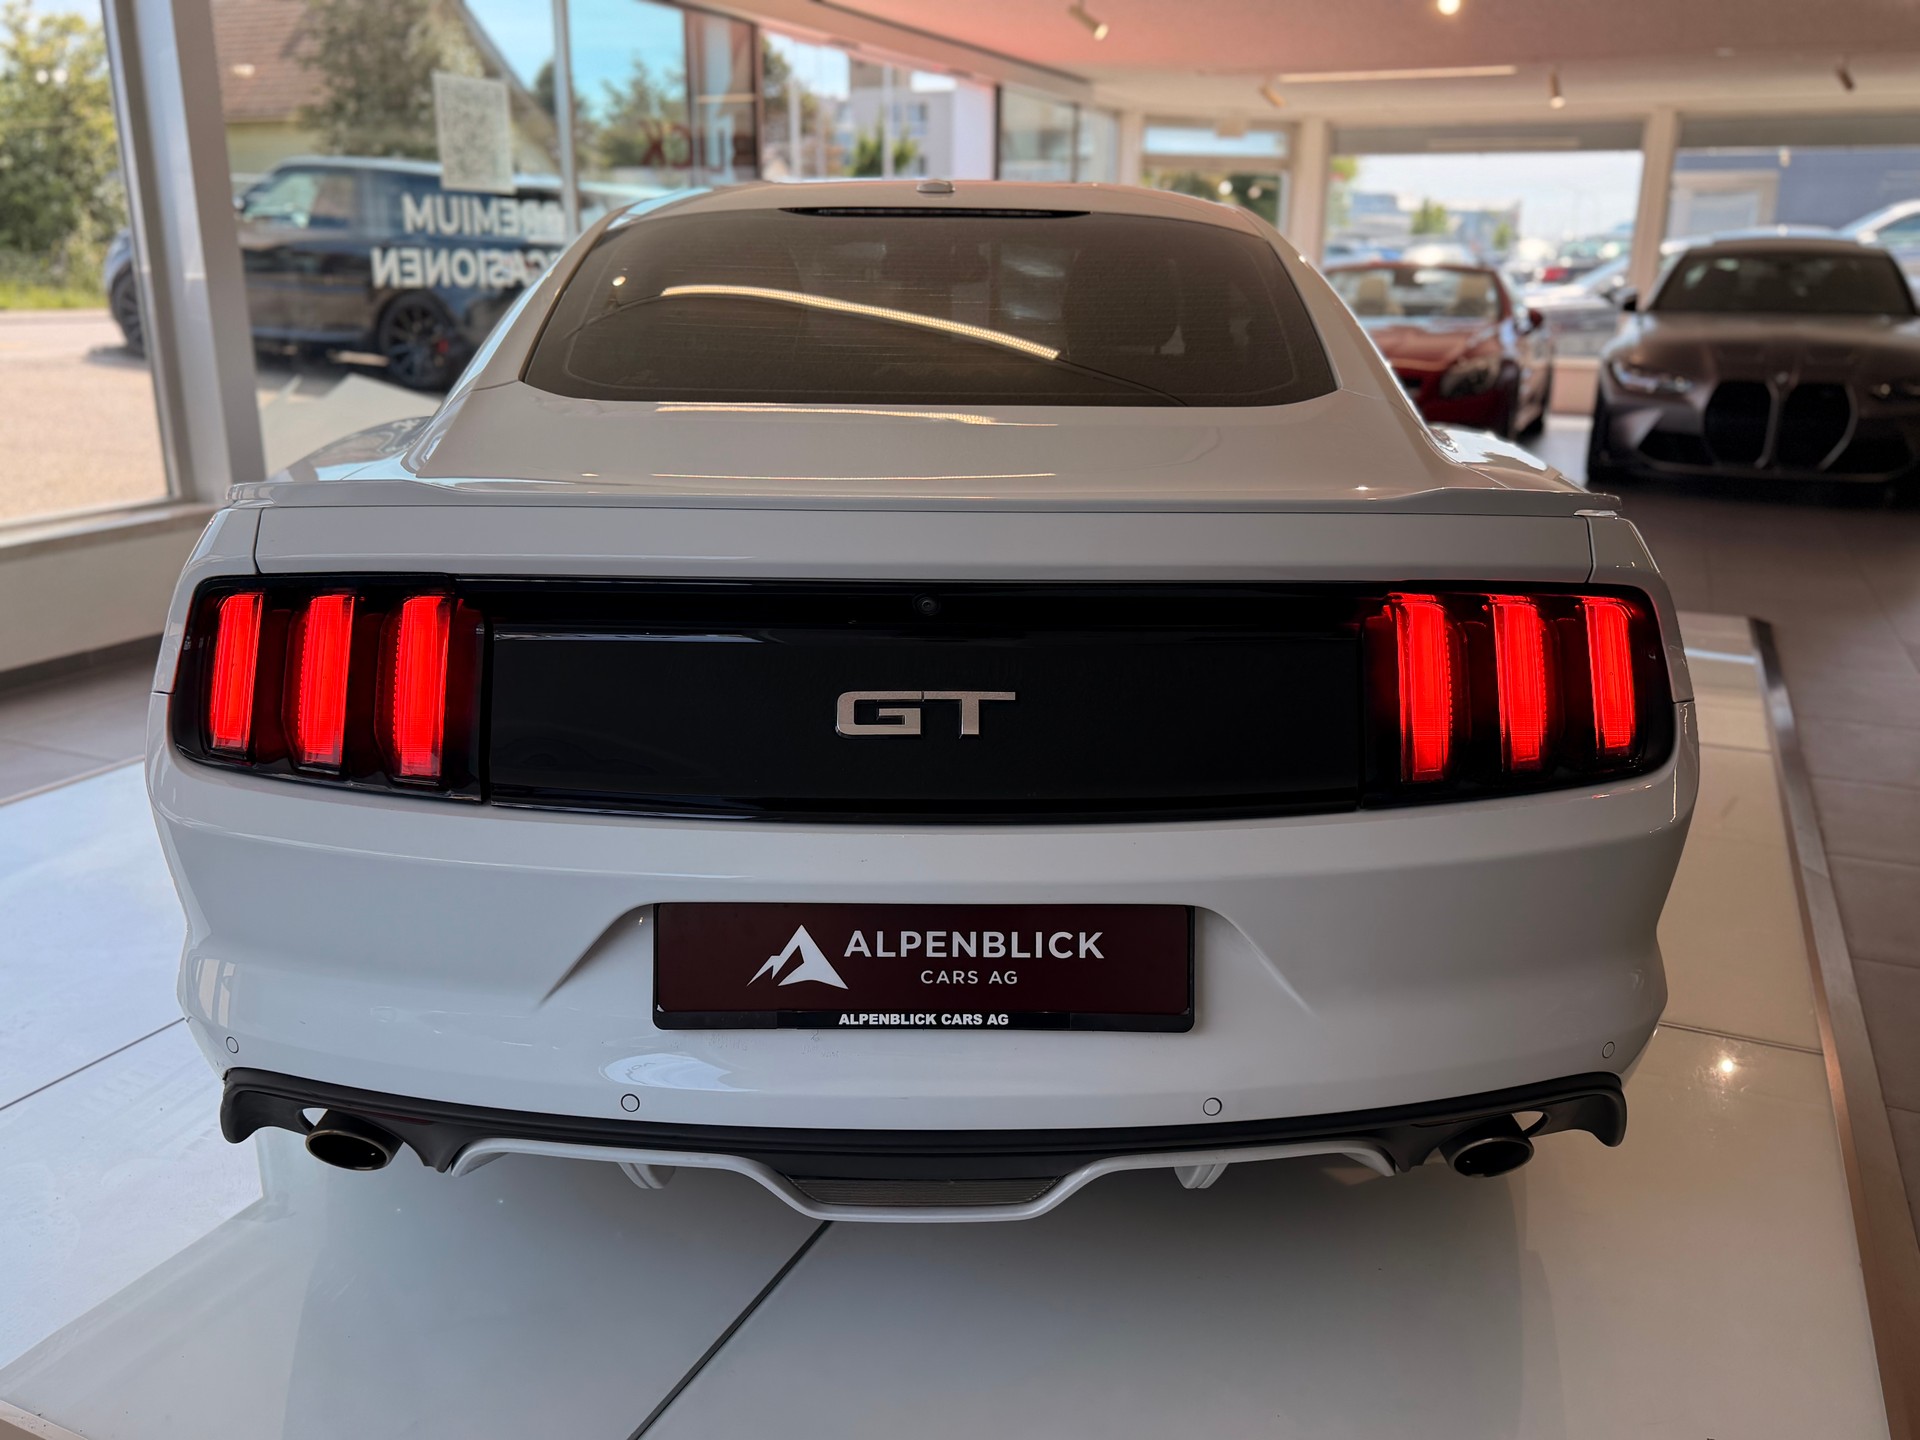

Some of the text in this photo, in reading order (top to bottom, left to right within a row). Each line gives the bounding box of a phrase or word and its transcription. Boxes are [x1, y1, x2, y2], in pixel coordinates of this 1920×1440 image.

[836, 690, 1016, 737] GT
[843, 930, 1105, 959] ALPENBLICK
[920, 970, 1018, 985] CARS AG
[838, 1013, 1009, 1026] ALPENBLICK CARS AG
